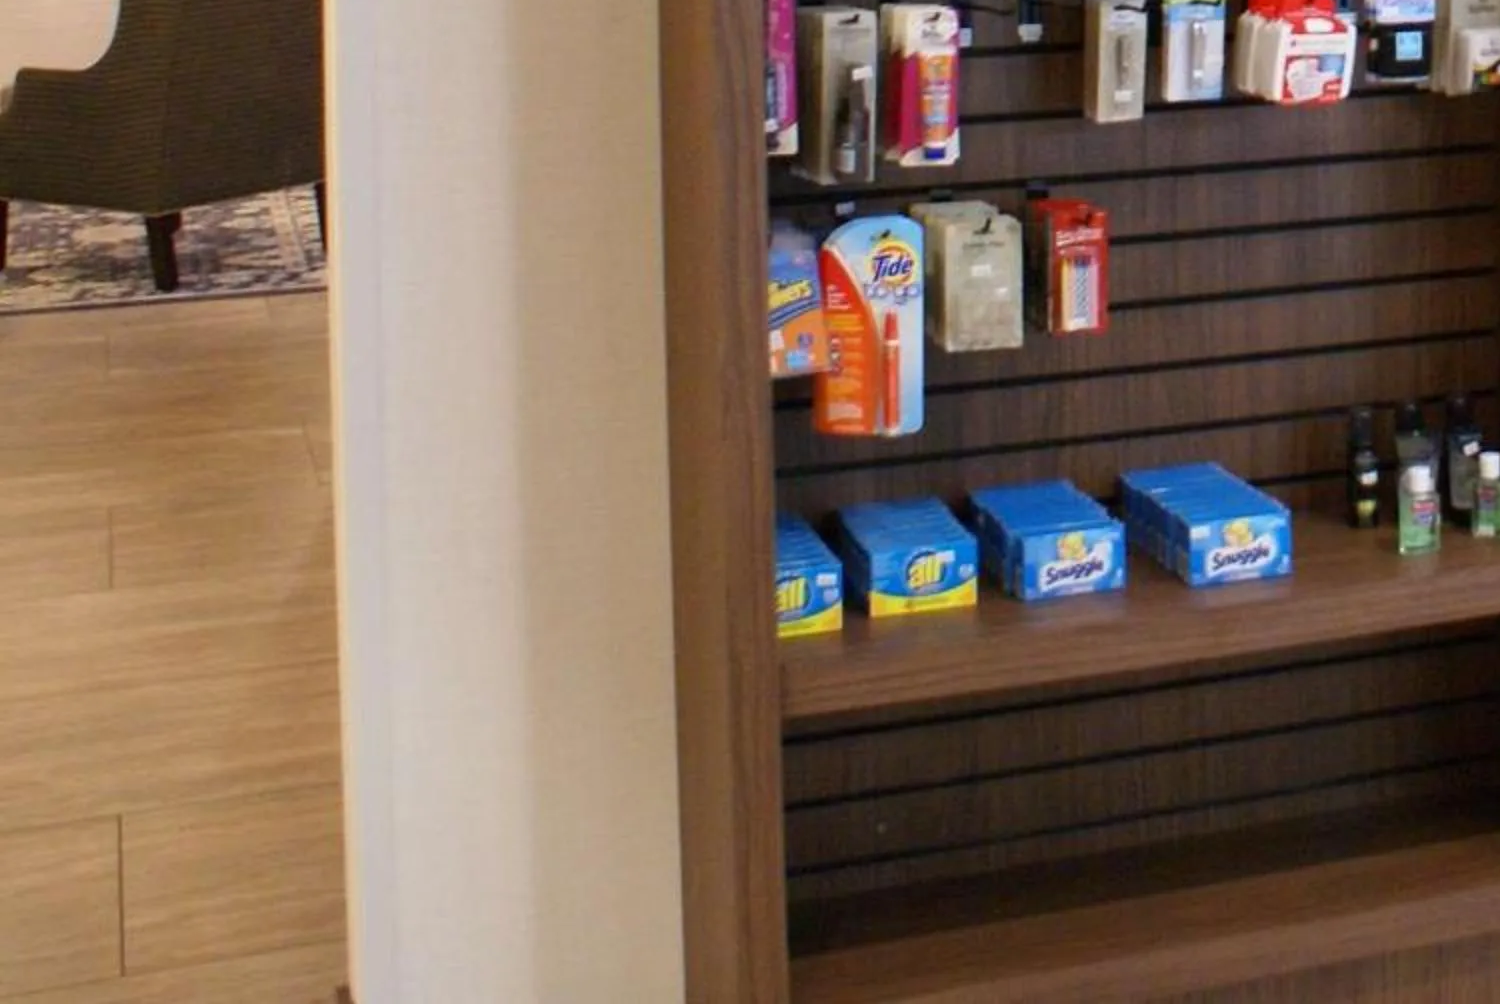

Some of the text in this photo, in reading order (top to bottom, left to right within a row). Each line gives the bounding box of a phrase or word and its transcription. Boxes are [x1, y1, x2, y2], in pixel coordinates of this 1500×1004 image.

[872, 253, 914, 283] Tide
[1045, 556, 1105, 585] Snuggle
[1211, 543, 1271, 571] Snuggle
[908, 556, 943, 588] all
